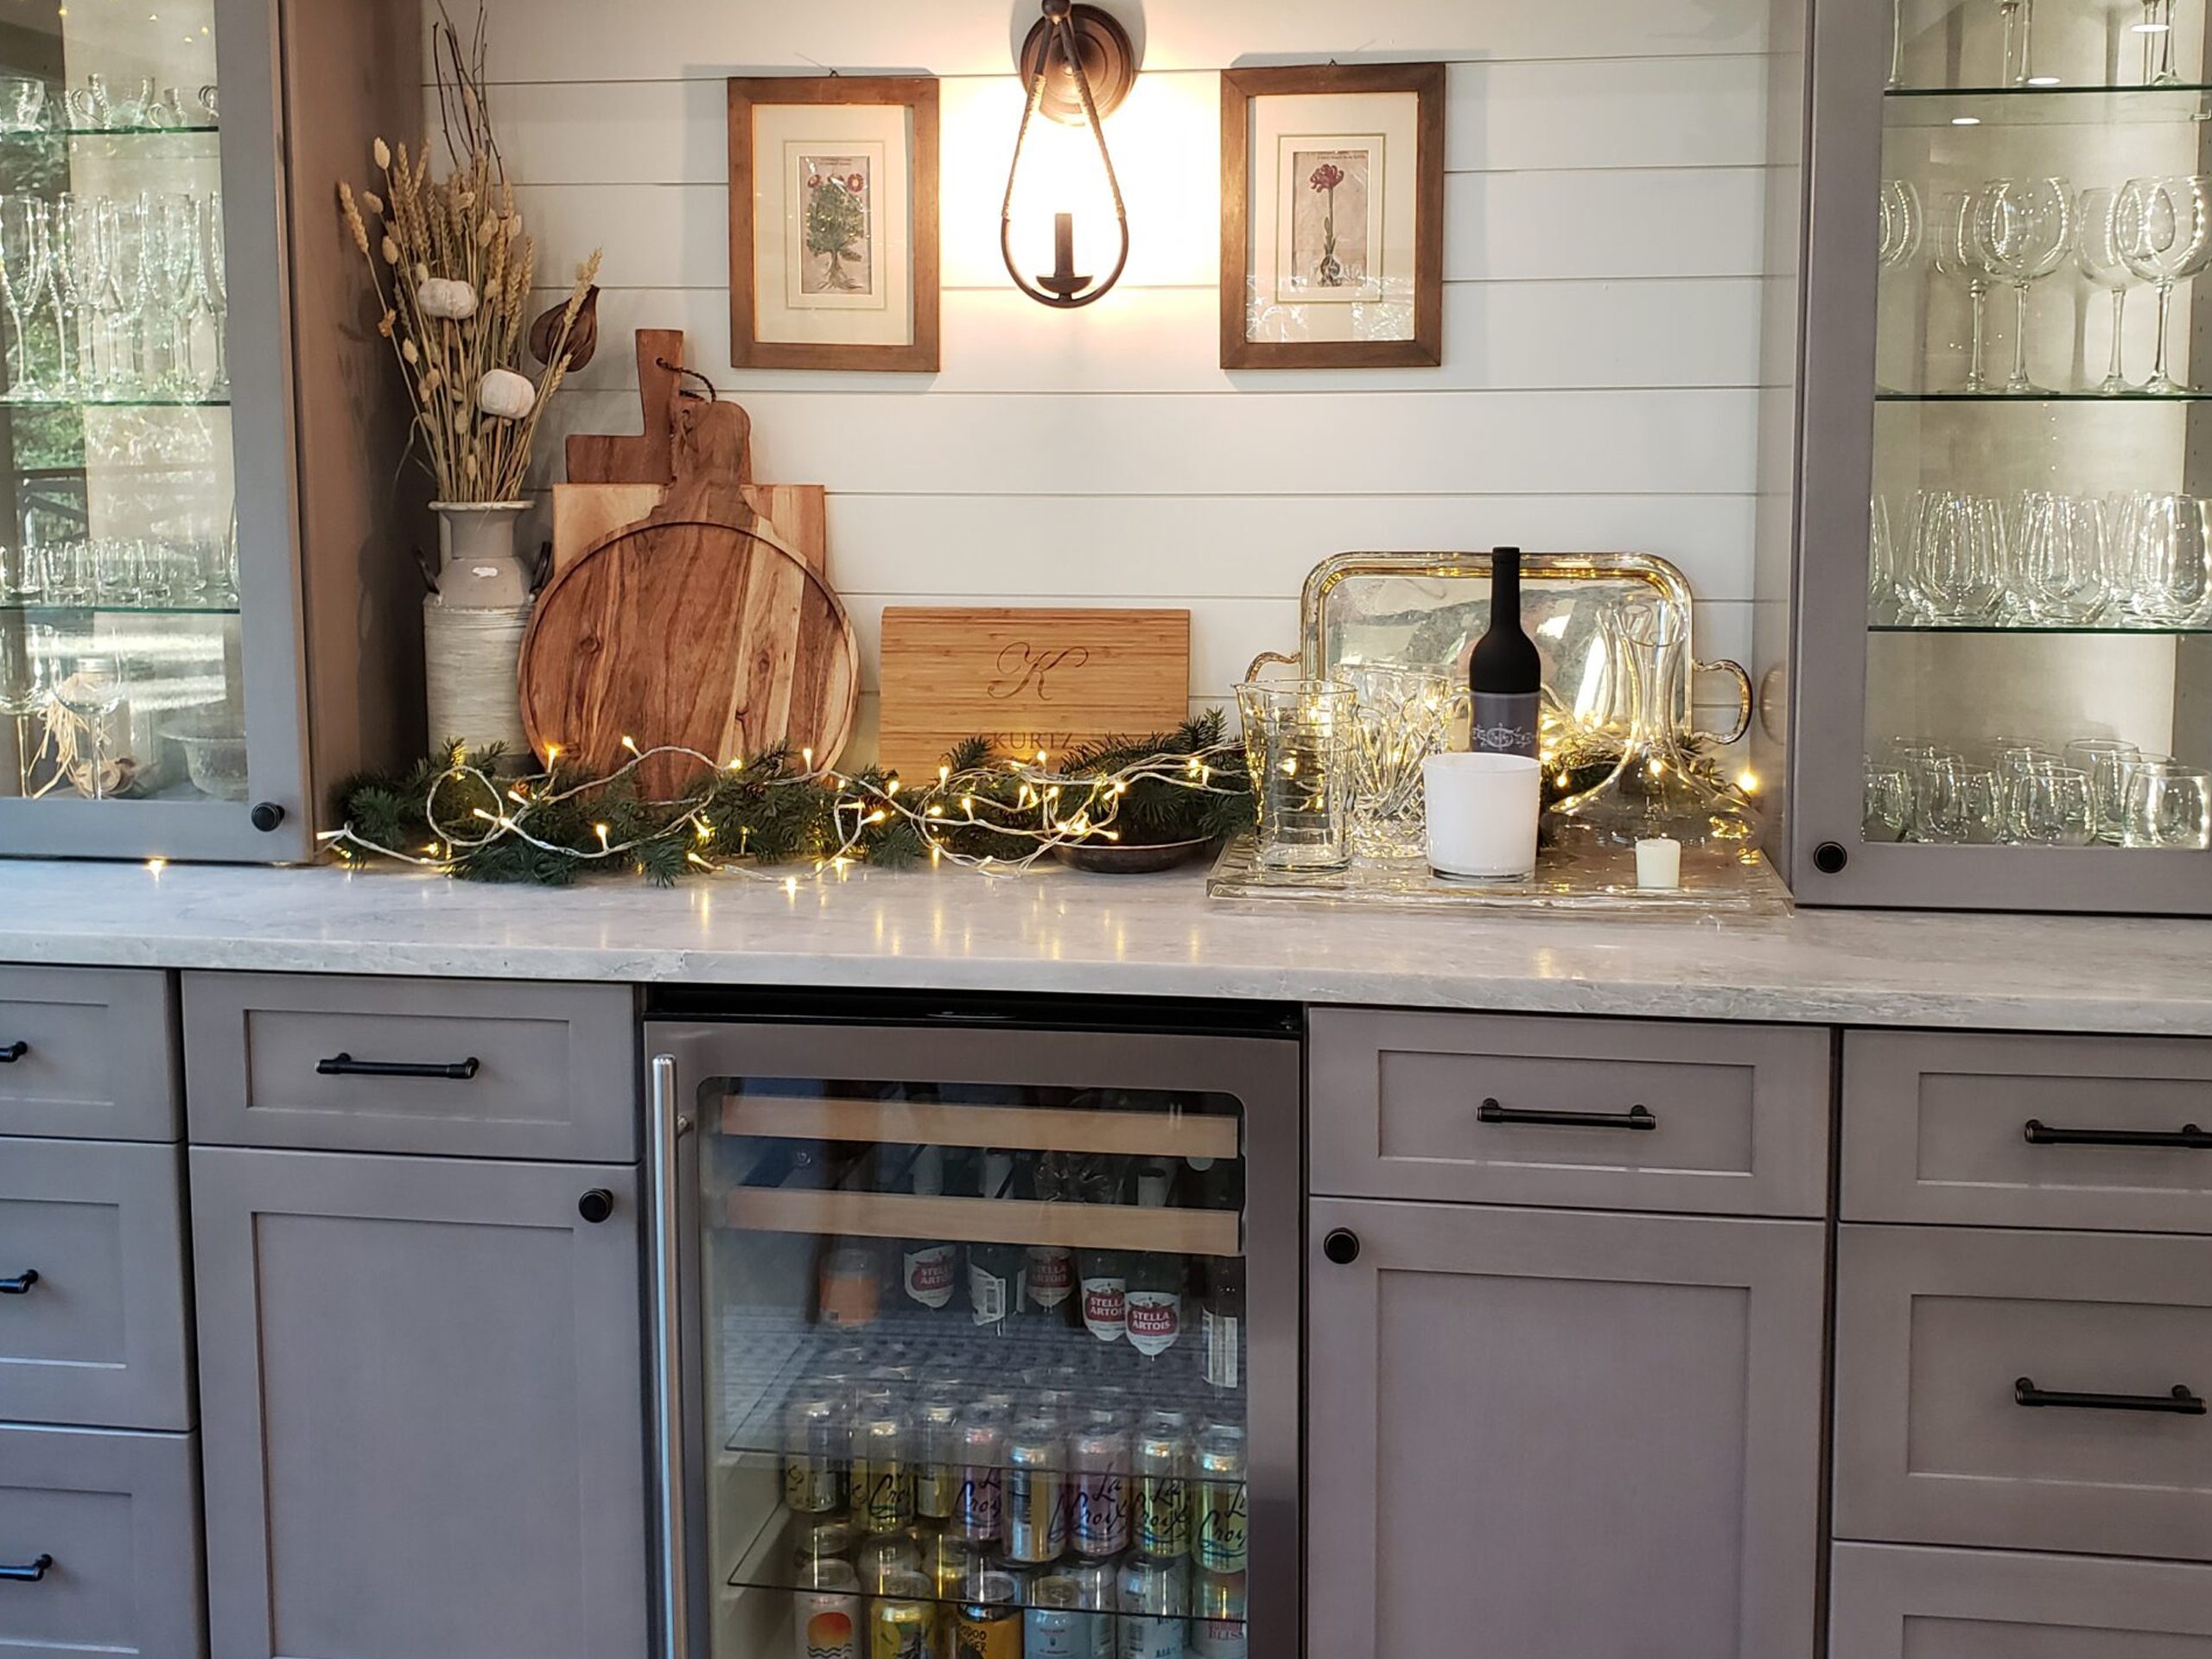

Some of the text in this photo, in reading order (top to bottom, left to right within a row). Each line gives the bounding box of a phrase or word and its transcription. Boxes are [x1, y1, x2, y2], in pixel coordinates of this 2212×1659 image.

[988, 641, 1089, 701] K
[992, 733, 1073, 749] KURTZ
[1133, 1310, 1170, 1322] STELLA
[1132, 1320, 1172, 1331] ARTOIS
[1092, 1462, 1122, 1501] La
